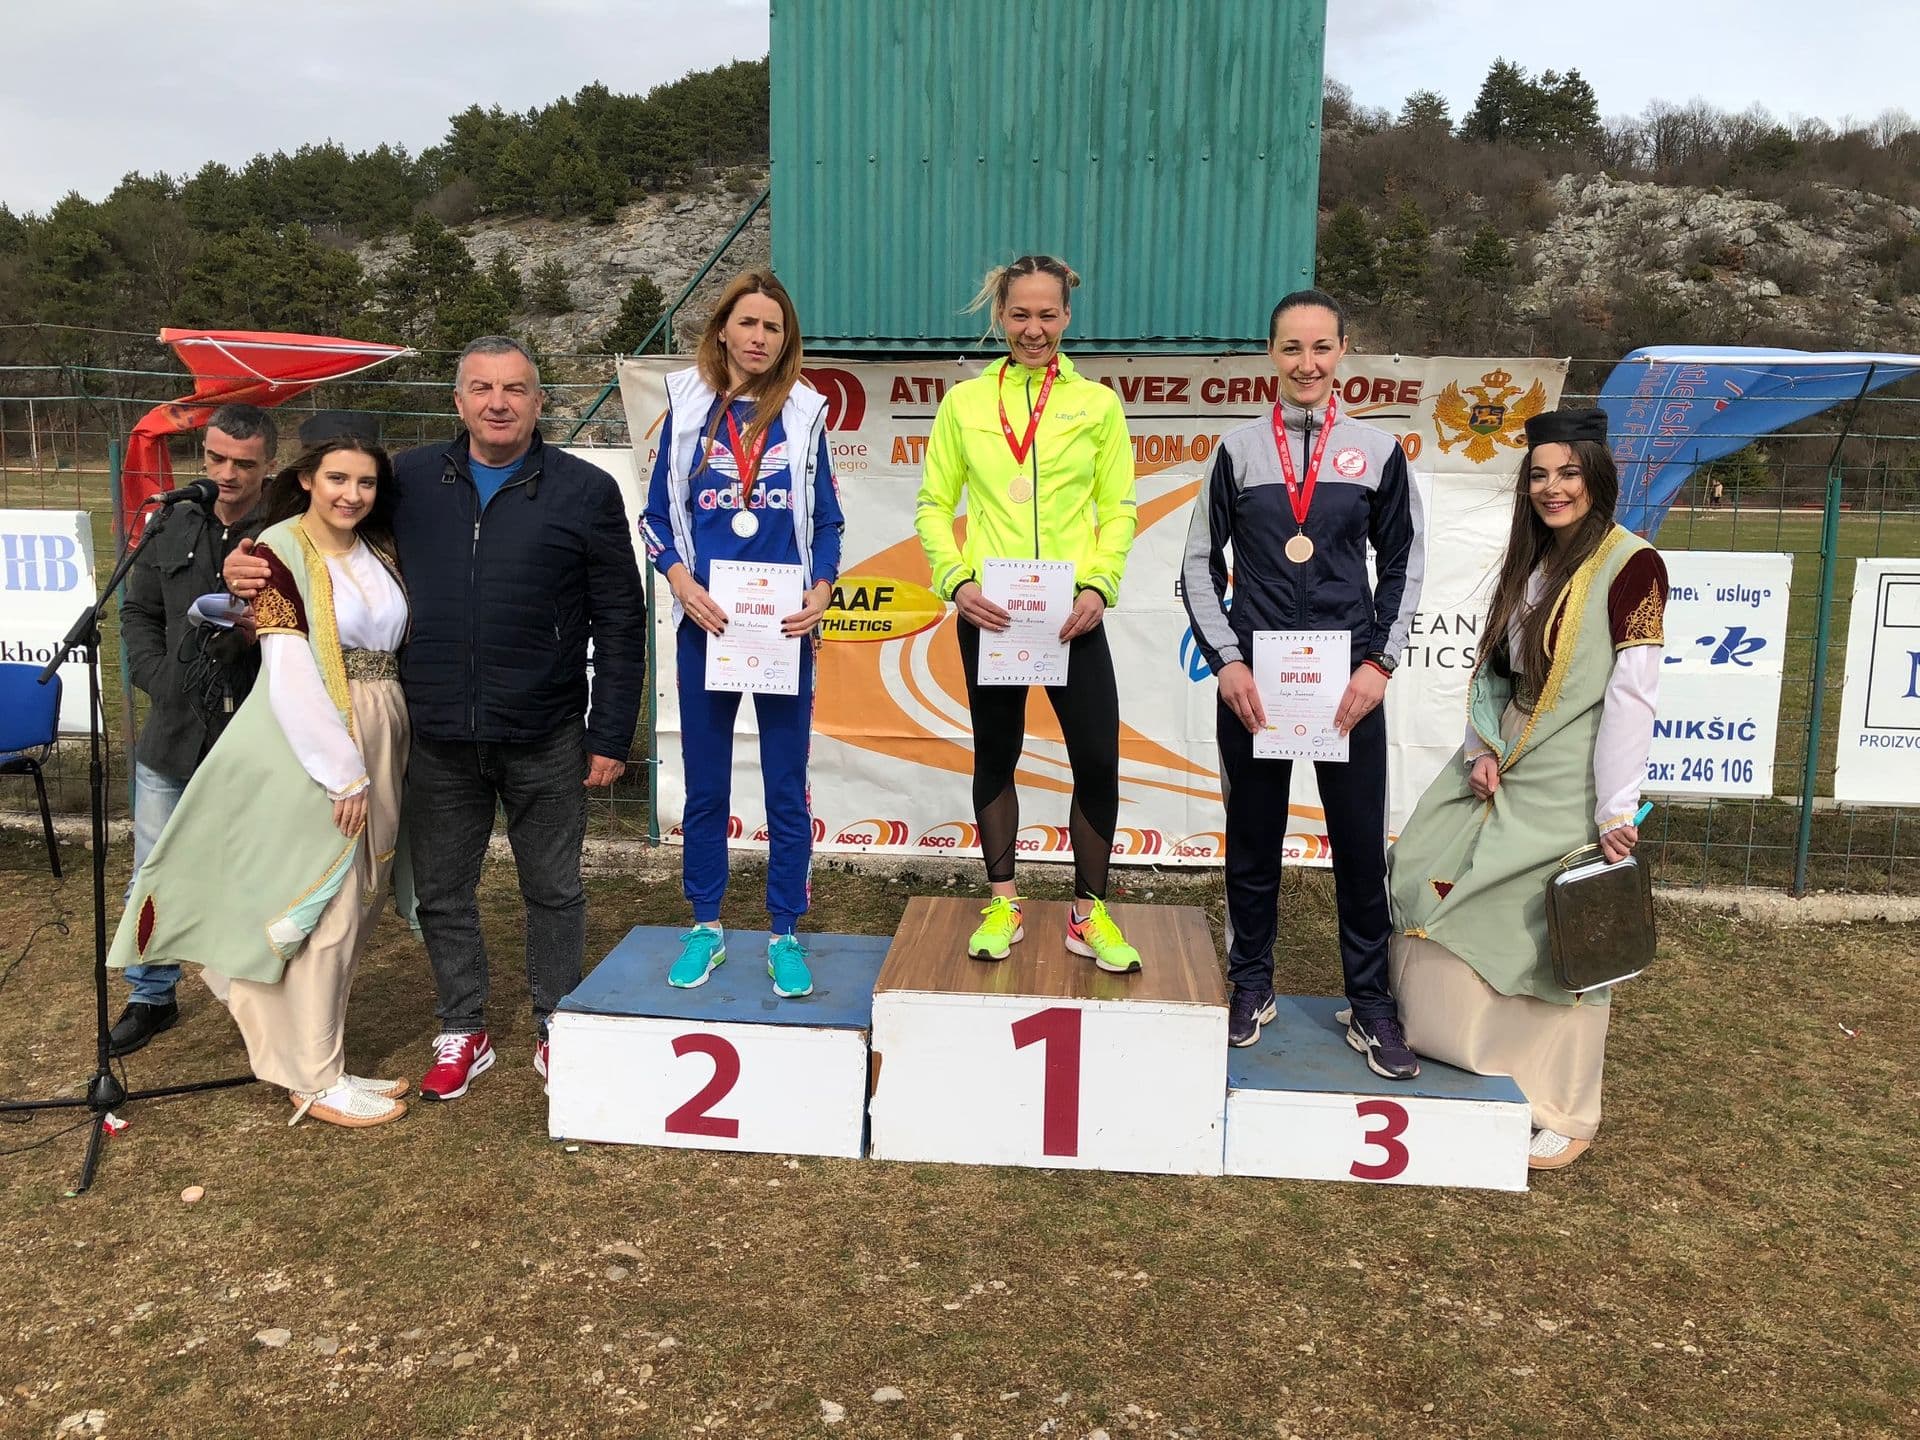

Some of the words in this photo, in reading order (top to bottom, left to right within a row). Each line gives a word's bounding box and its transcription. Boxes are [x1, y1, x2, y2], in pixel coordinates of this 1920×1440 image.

[1653, 364, 1708, 447] tletski
[735, 602, 775, 616] DIPLOMU
[1007, 599, 1047, 612] DIPLOMU
[1280, 671, 1322, 684] DIPLOMU
[1653, 716, 1757, 741] NIKŠIĆ
[1681, 757, 1714, 782] 246
[1721, 758, 1753, 783] 106
[836, 834, 873, 845] ASCG
[918, 836, 956, 848] ASCG
[664, 1033, 742, 1138] 2
[1011, 1007, 1082, 1157] 1
[1349, 1100, 1410, 1180] 3
